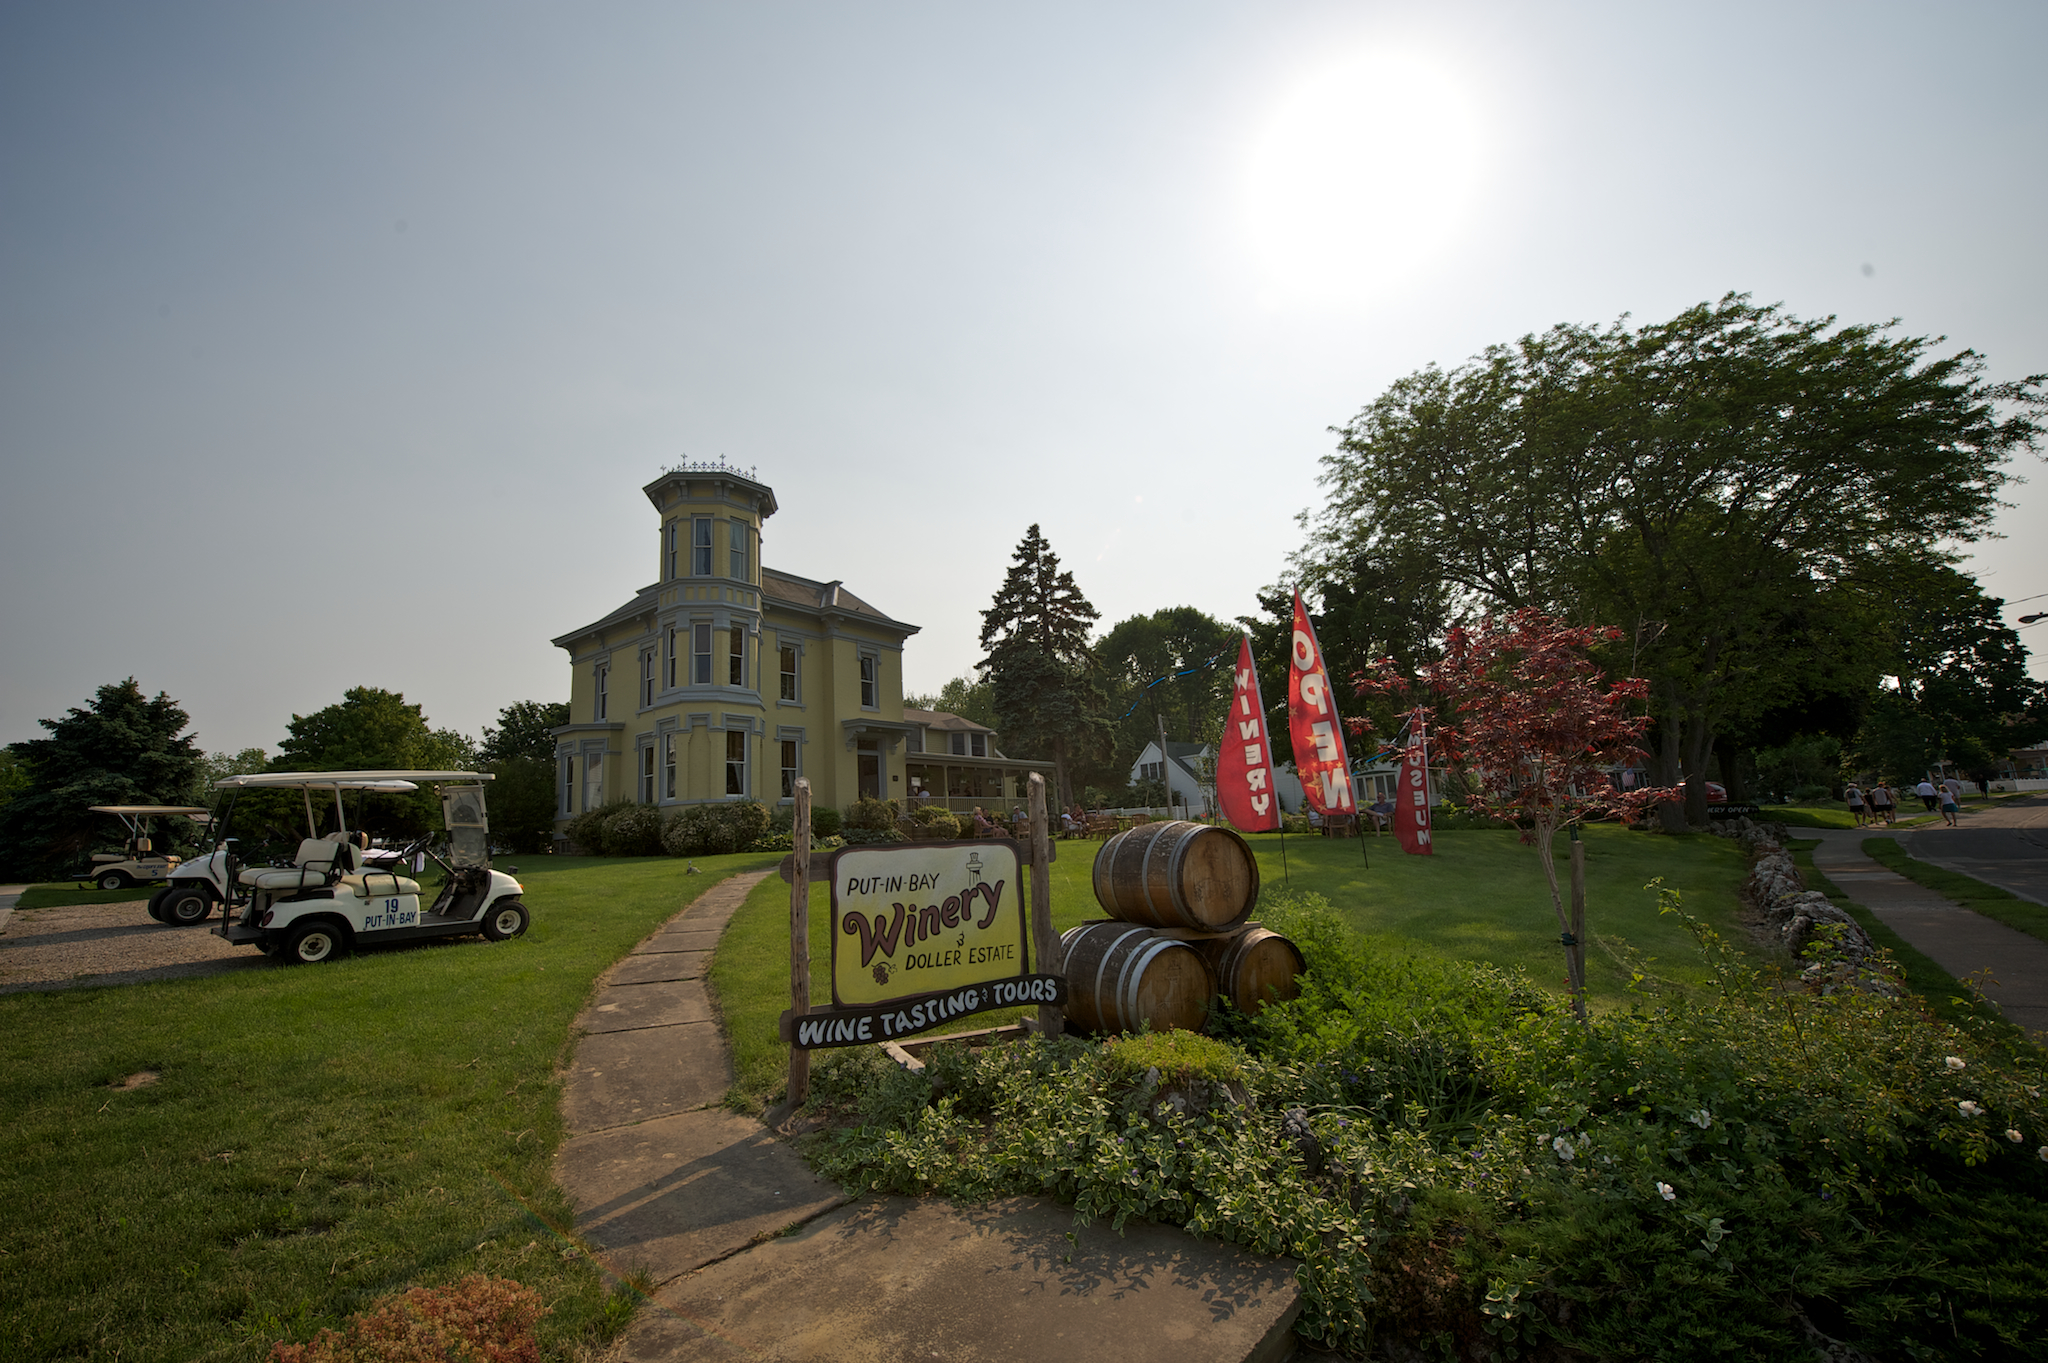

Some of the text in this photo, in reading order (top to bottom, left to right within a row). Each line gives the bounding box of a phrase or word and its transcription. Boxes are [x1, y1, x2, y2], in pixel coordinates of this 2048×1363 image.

[151, 869, 158, 877] 5
[847, 873, 940, 896] PUT-IN-BAY
[385, 898, 399, 914] 19
[365, 911, 416, 929] PUT-IN-BAY
[842, 879, 1005, 968] Winery
[905, 944, 1014, 970] DOLLER ESTATE
[798, 1016, 873, 1046] WINE
[880, 988, 979, 1036] TASTING
[993, 978, 1058, 1005] TOURS
